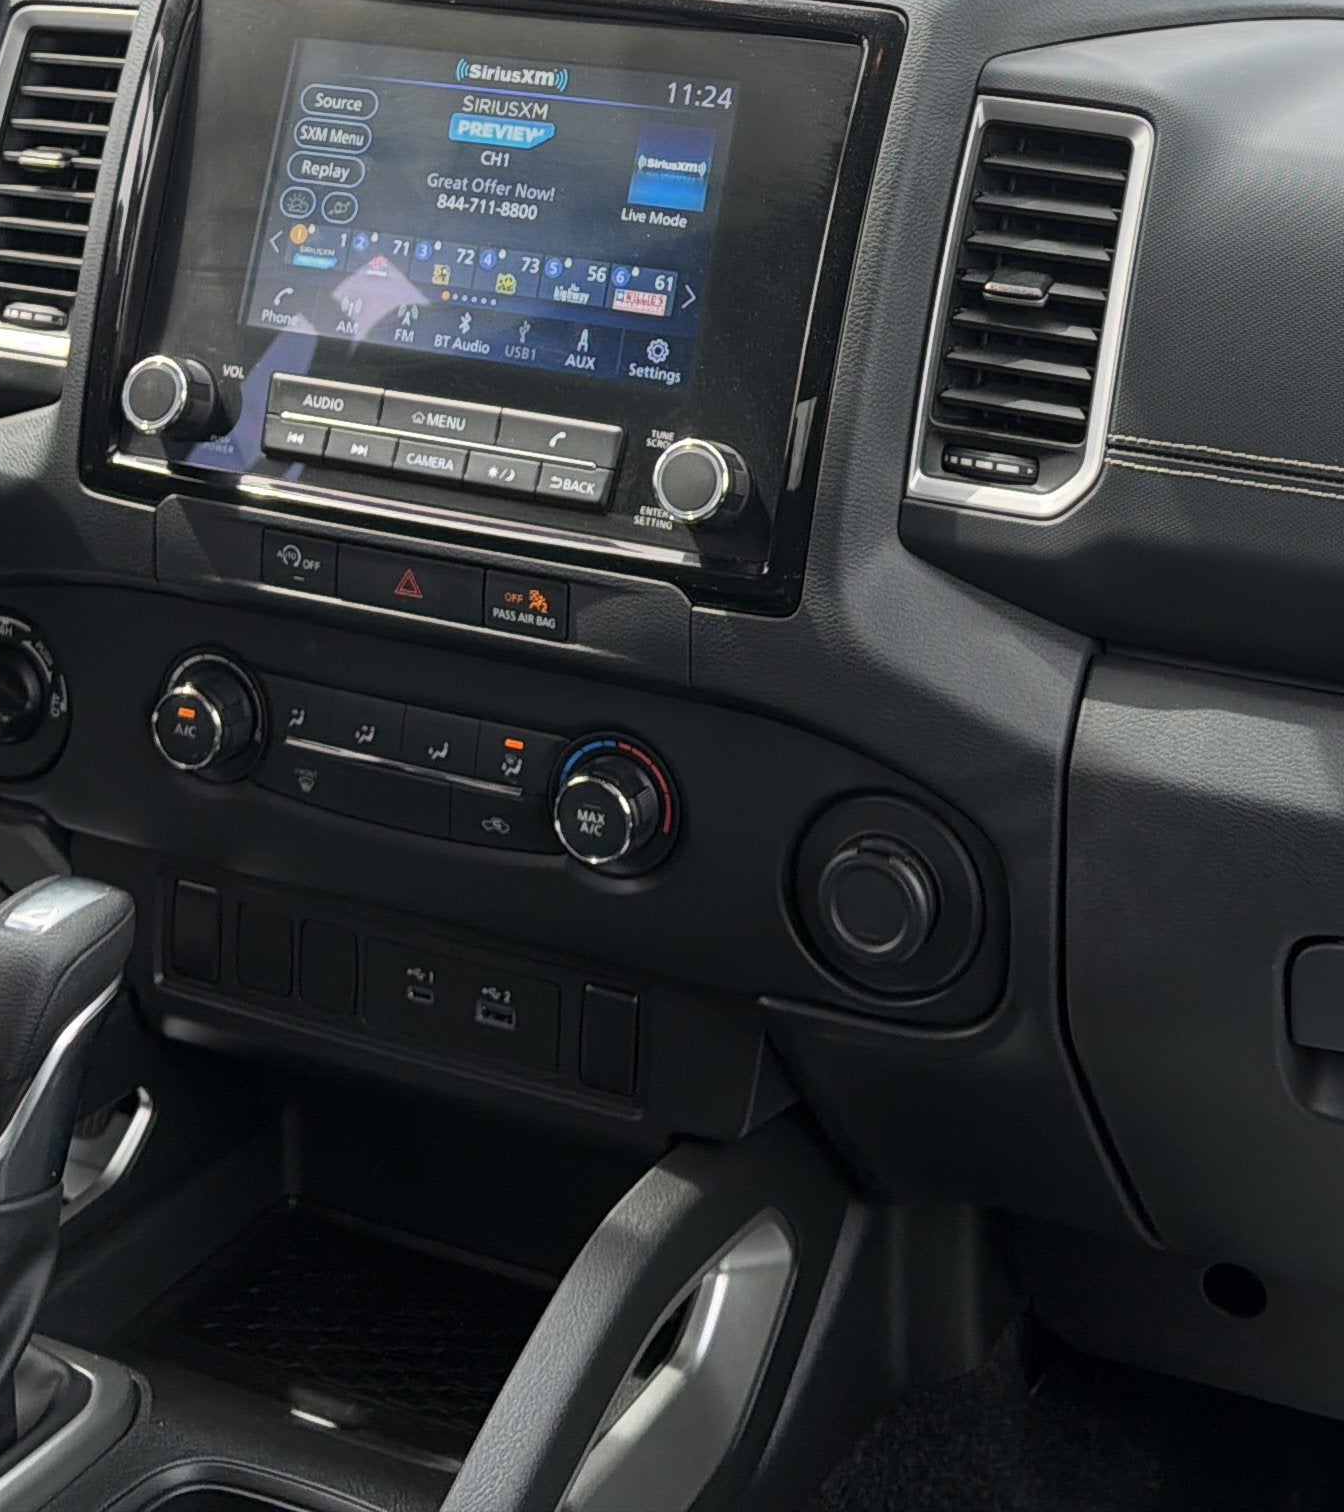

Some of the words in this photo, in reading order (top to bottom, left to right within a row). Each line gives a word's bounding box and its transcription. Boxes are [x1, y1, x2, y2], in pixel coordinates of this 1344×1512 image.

[314, 92, 363, 112] Source
[667, 81, 733, 110] 11:24
[462, 95, 549, 120] SIRIUSXM
[299, 125, 328, 142] SXM
[329, 130, 364, 147] Menu
[457, 119, 545, 142] PREVIEW
[480, 150, 511, 168] CH1
[301, 159, 351, 182] Replay
[427, 172, 468, 190] Great
[471, 177, 512, 196] Offer
[515, 183, 556, 202] Now!
[437, 194, 539, 221] 844-711-8800
[620, 207, 647, 224] Live
[649, 210, 688, 228] Mode
[340, 233, 348, 248] 1
[393, 239, 410, 257] 71
[456, 248, 474, 265] 72
[522, 256, 541, 274] 73
[587, 265, 607, 283] 56
[655, 274, 674, 292] 61
[261, 308, 299, 327] Phone
[336, 320, 359, 335] AM
[394, 328, 415, 343] FM
[434, 334, 450, 348] BT
[452, 336, 491, 355] Audio
[505, 344, 537, 362] USB1
[564, 352, 597, 371] AUX
[222, 364, 245, 380] VOL
[628, 362, 681, 386] Settings
[302, 393, 345, 411] AUDIO
[425, 411, 467, 432] MENU
[645, 438, 671, 450] SCRO
[651, 428, 675, 442] TUNE
[406, 452, 454, 472] CAMERA
[563, 477, 596, 497] BACK
[639, 504, 669, 519] ENTER
[633, 514, 673, 530] SETTING
[302, 558, 322, 571] OFF
[504, 591, 524, 605] OFF
[492, 607, 517, 622] PASS
[518, 610, 535, 626] AIR
[536, 614, 556, 630] BAG
[174, 723, 198, 738] A/C
[577, 808, 606, 826] MAX
[579, 821, 604, 836] A/C
